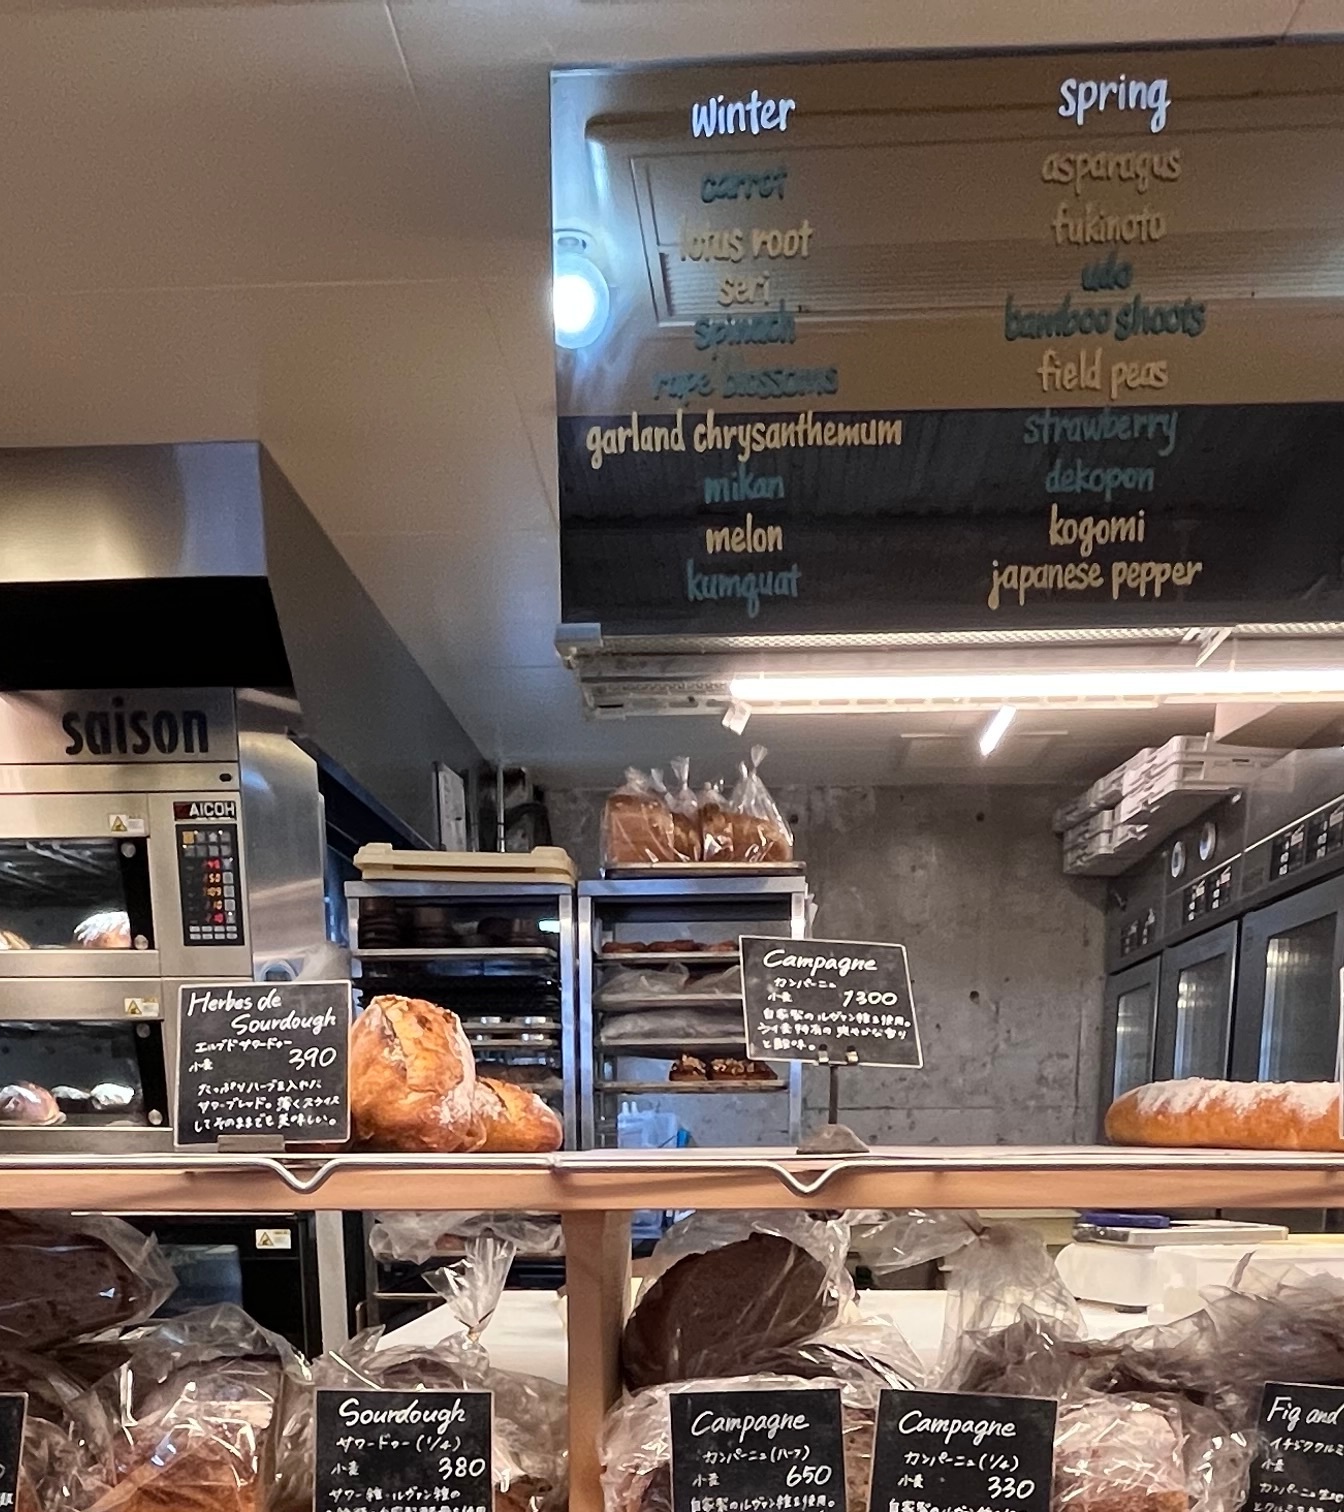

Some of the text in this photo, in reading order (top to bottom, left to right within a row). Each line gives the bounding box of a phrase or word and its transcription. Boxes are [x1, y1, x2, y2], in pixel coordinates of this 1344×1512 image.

[692, 90, 795, 139] winter
[1059, 75, 1171, 131] spring
[701, 166, 787, 203] carrot
[1042, 148, 1181, 195] asparagus
[752, 219, 813, 260] root
[718, 271, 770, 307] seri
[1081, 258, 1131, 292] udo
[1004, 295, 1109, 342] bamboo
[1037, 348, 1170, 399] field peas
[587, 408, 902, 468] garland chrysanthemum
[1024, 407, 1179, 456] strawberry
[703, 464, 785, 503] mikan
[1044, 462, 1155, 499] dekopon
[705, 514, 783, 553] melon
[1049, 504, 1146, 562] kogomi
[686, 559, 803, 617] kumquat
[988, 558, 1203, 610] japanese pepper
[62, 697, 209, 756] saison
[189, 802, 235, 817] AICOH
[763, 949, 878, 977] Campagne
[187, 988, 282, 1017] Herbes de
[842, 989, 898, 1007] 1300
[231, 1006, 337, 1035] Sourdough
[289, 1047, 337, 1070] 390
[339, 1397, 466, 1435] Sourdough
[691, 1410, 810, 1444] Campagne
[898, 1410, 1017, 1446] Campagne
[1267, 1396, 1302, 1432] Fig
[438, 1456, 486, 1480] 380
[786, 1465, 832, 1487] 650
[987, 1475, 1035, 1499] 330
